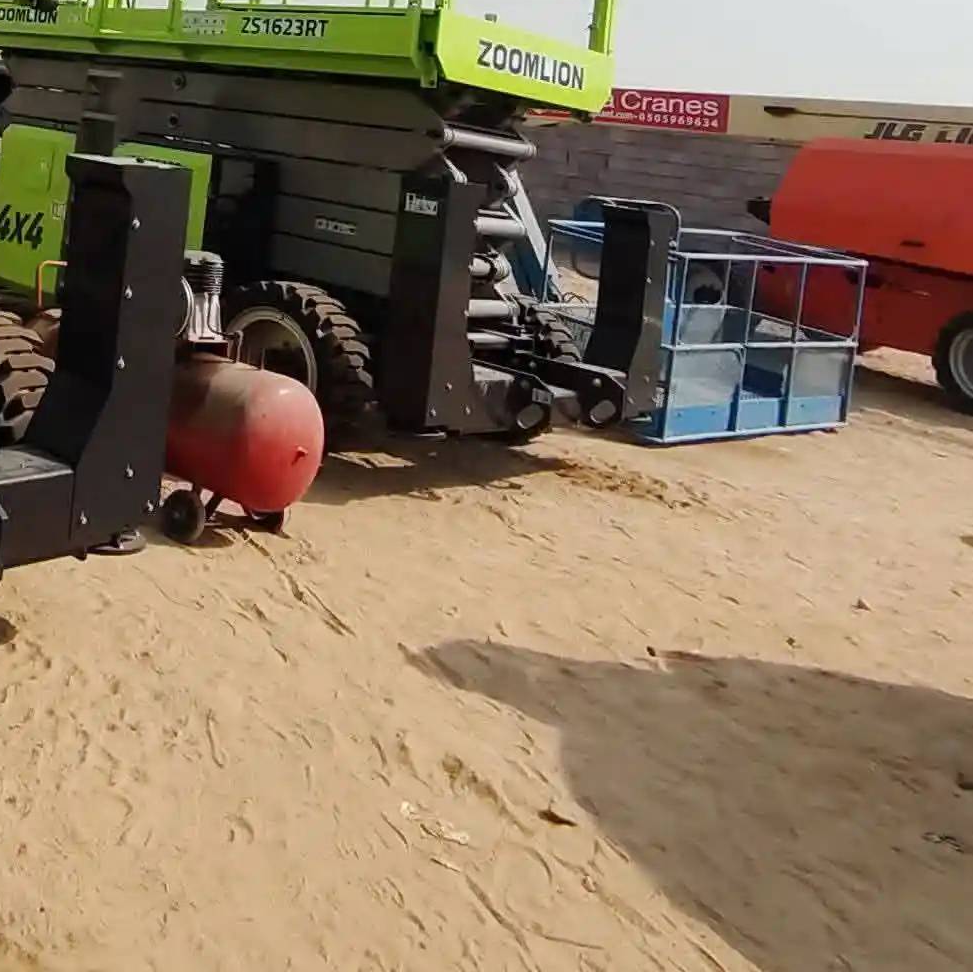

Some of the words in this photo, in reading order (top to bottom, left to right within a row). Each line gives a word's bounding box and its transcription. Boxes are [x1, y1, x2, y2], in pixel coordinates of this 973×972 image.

[240, 16, 330, 37] ZS1623RT
[476, 38, 584, 91] ZOOMLION
[620, 90, 719, 117] Cranes
